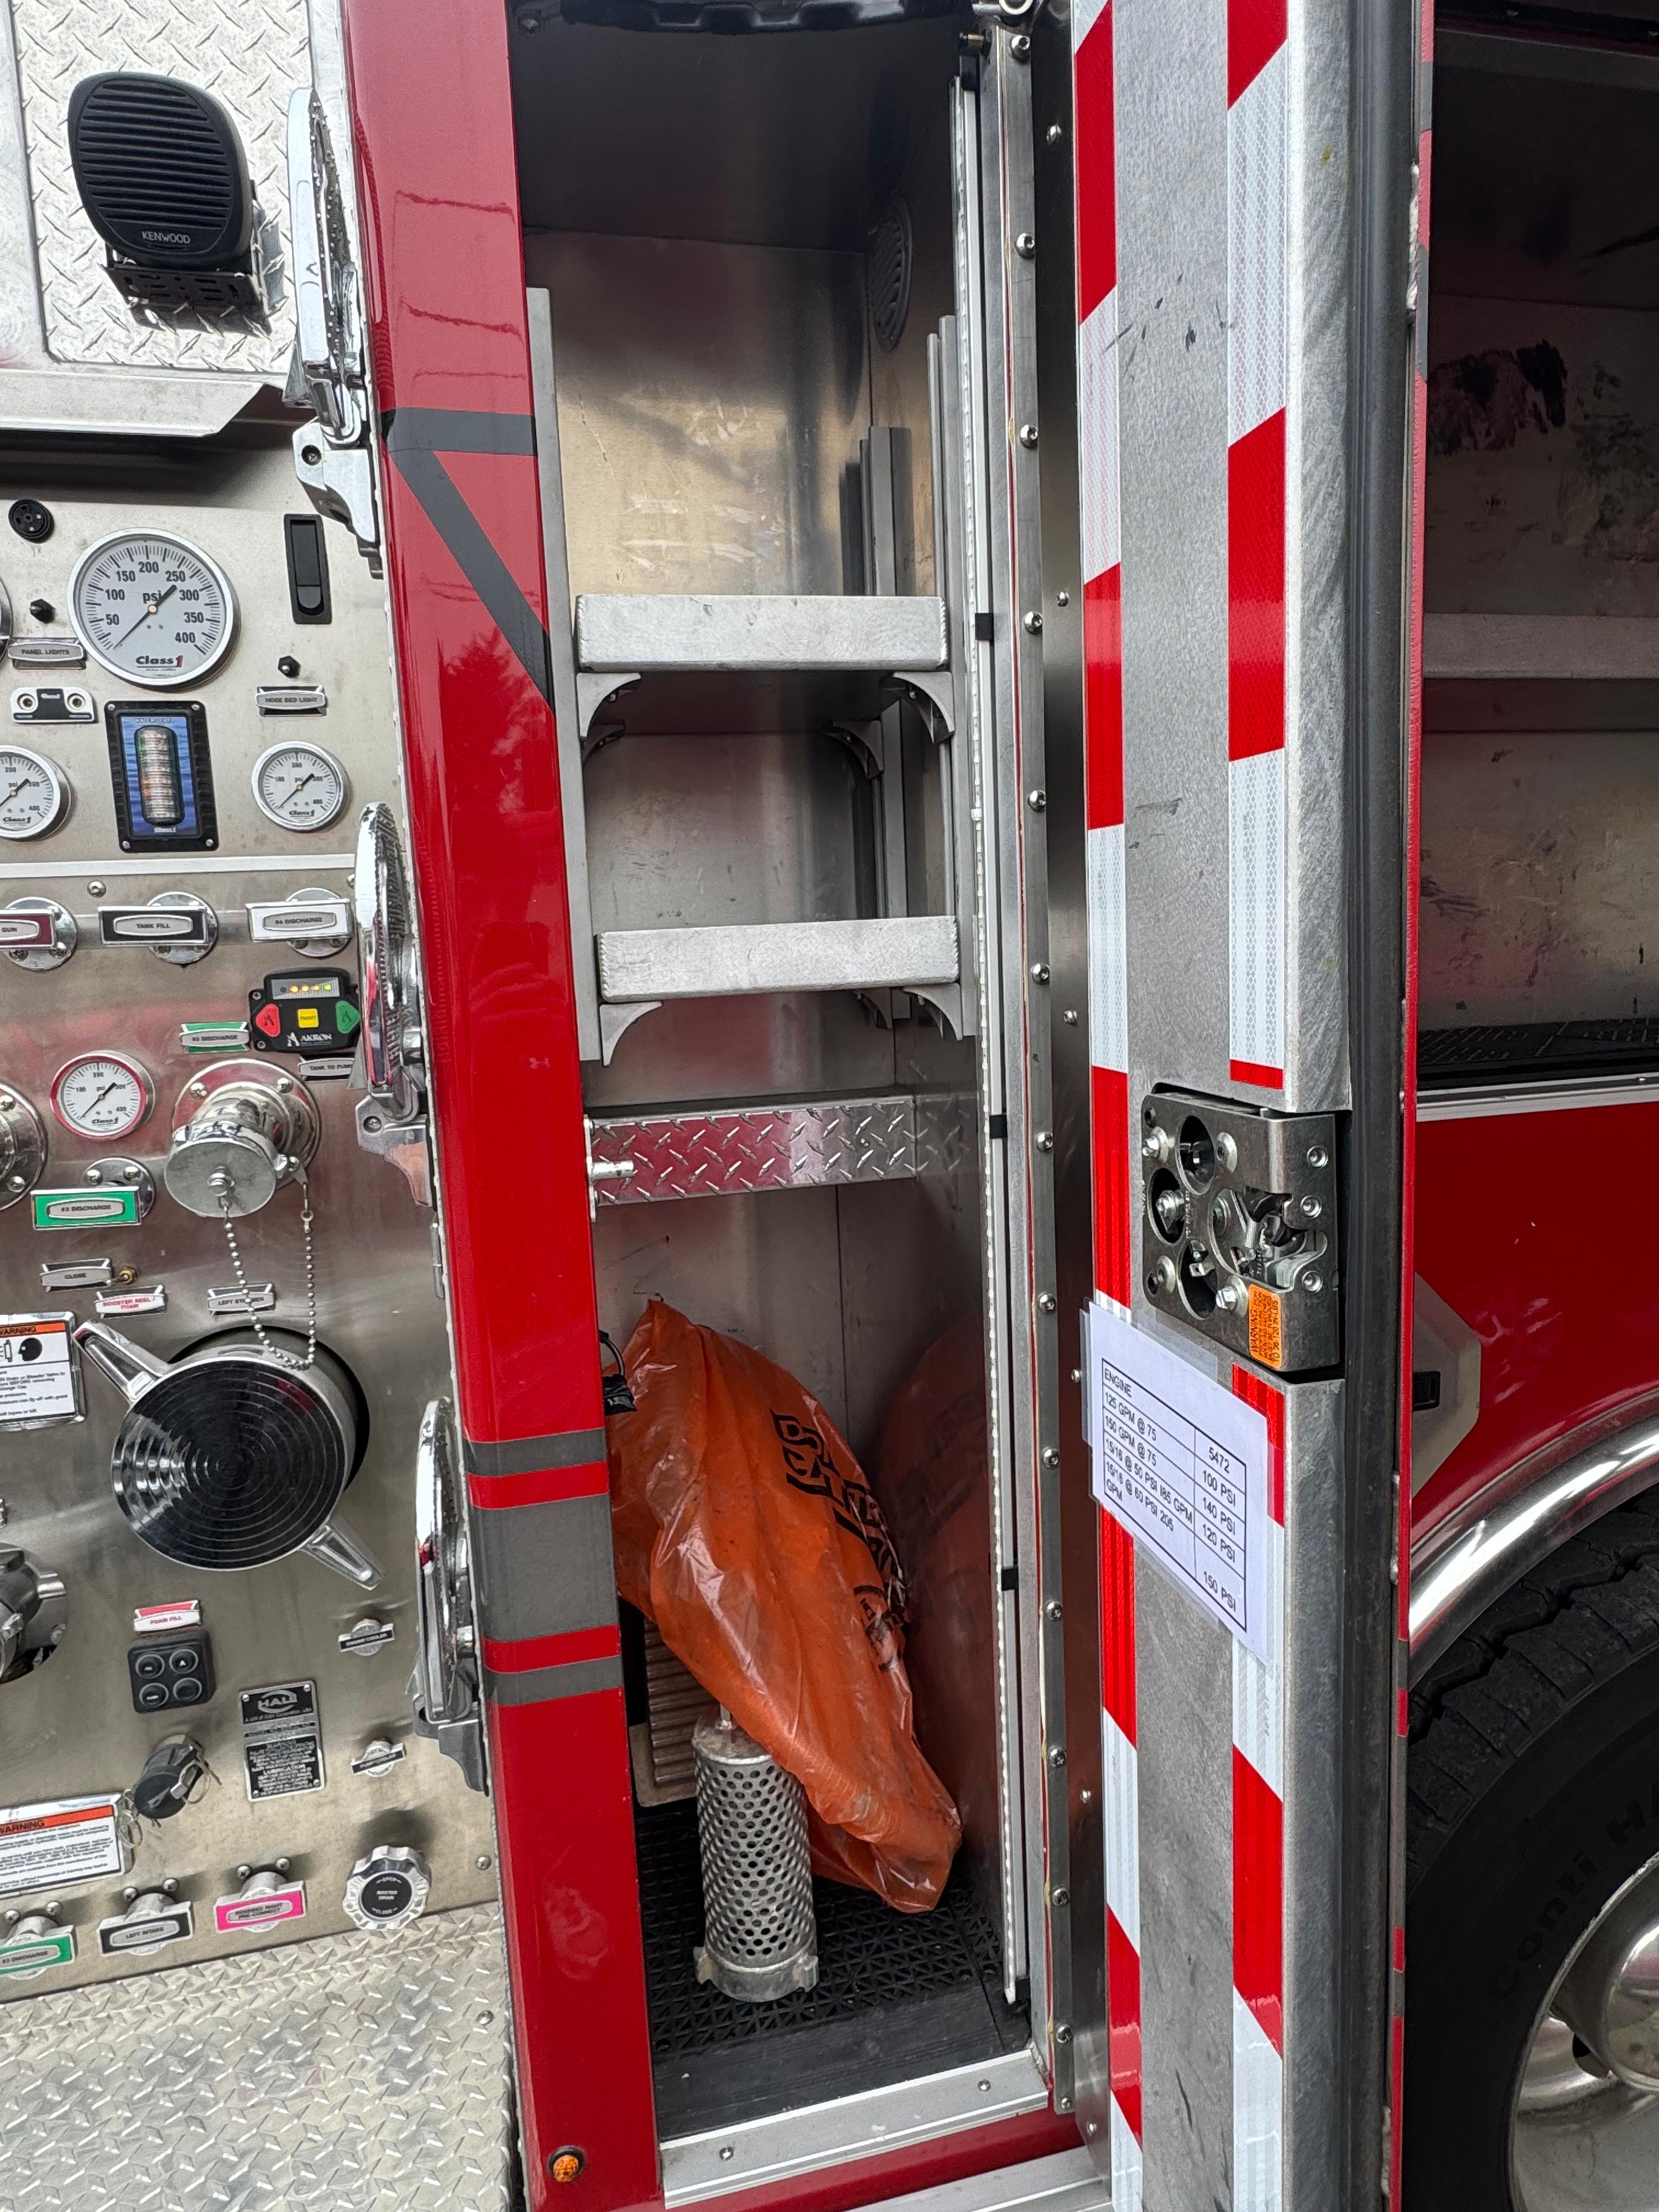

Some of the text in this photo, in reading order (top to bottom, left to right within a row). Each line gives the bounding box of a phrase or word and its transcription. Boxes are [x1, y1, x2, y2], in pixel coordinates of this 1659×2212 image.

[142, 231, 190, 244] KENWOOD
[138, 562, 159, 573] 200
[116, 570, 135, 582] 150
[165, 570, 185, 582] 250
[105, 588, 125, 600] 100
[142, 590, 162, 604] psi
[179, 589, 199, 601] 300
[106, 613, 119, 625] 50
[184, 612, 204, 623] 350
[175, 632, 195, 643] 400
[300, 1034, 332, 1042] AKRON
[1104, 1368, 1132, 1398] ENGINE
[1105, 1392, 1156, 1441] 125 GPM @ 75
[1105, 1416, 1156, 1467] 150 GPM @ 75
[1209, 1447, 1230, 1474] 5472
[1106, 1438, 1123, 1462] 15/16
[1125, 1455, 1133, 1472] @
[1134, 1463, 1142, 1479] 50
[1145, 1472, 1157, 1493] PSI
[1173, 1498, 1192, 1524] GPM
[1107, 1479, 1123, 1501] GPM
[1203, 1470, 1235, 1507] 100 PSI
[1125, 1479, 1133, 1495] @
[1145, 1496, 1157, 1517] PSI
[1203, 1497, 1235, 1536] 140 PSI
[1203, 1524, 1235, 1563] 120 PSI
[1203, 1571, 1236, 1613] 150 PSI
[12, 1950, 48, 1961] DISCHARGE
